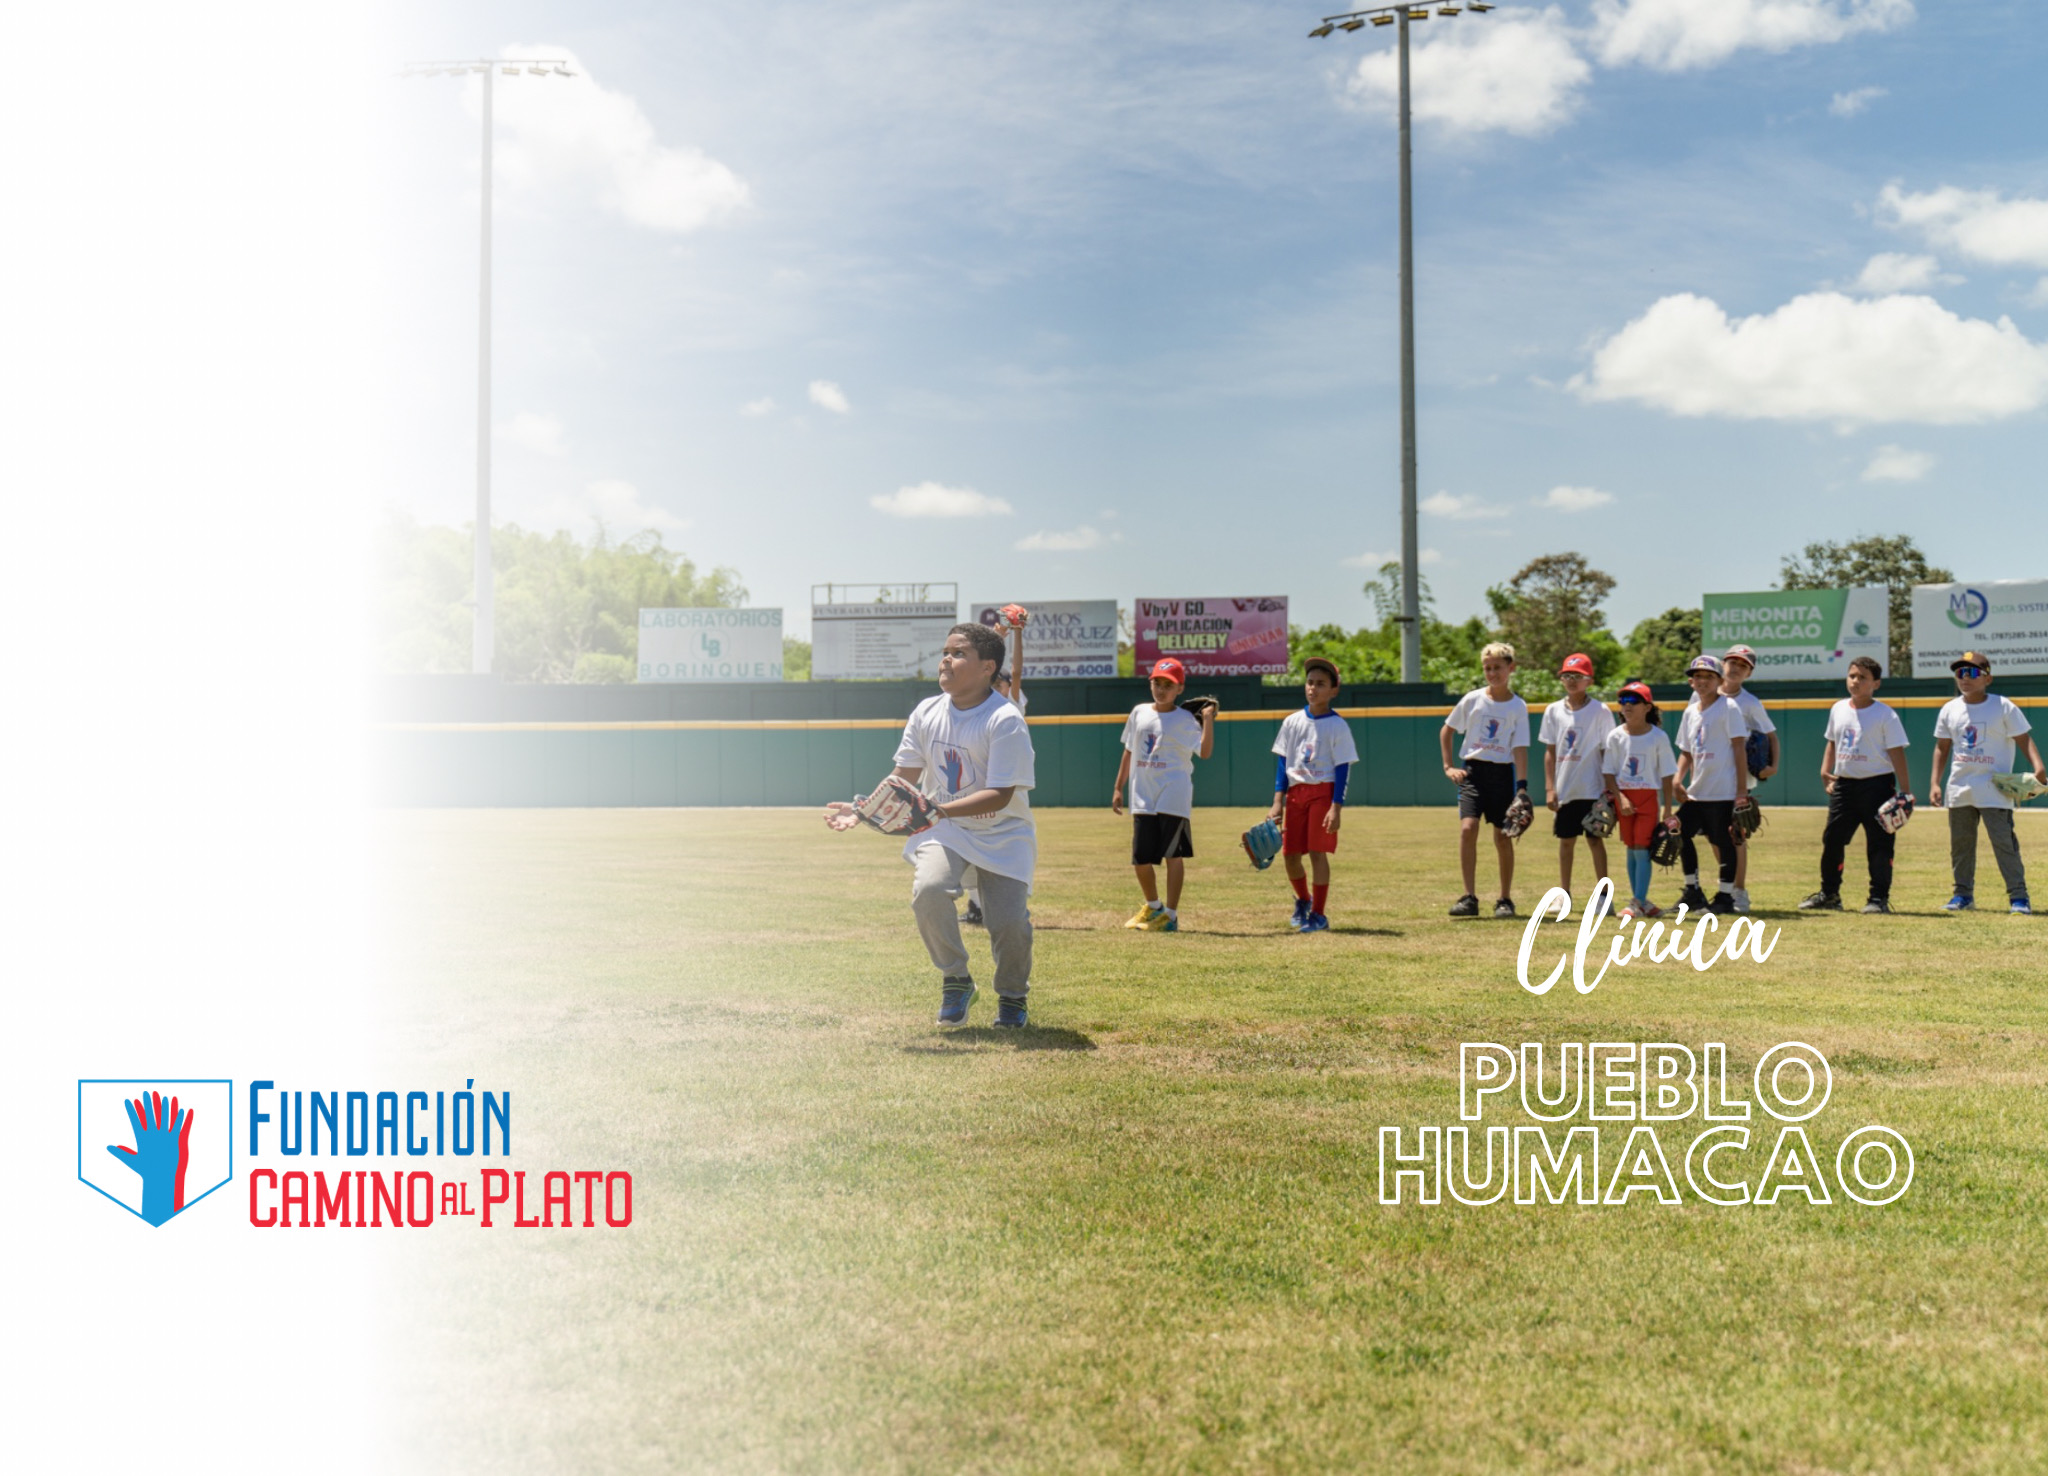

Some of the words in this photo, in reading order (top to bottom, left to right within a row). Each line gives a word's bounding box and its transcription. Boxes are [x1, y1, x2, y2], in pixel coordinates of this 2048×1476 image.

[915, 604, 956, 614] FLORES
[1142, 601, 1179, 618] VbyV
[1710, 606, 1823, 624] MENONITA
[1991, 604, 2016, 614] DATA
[641, 611, 782, 628] LABORATORIOS
[1712, 624, 1822, 641] HUMACAO
[1073, 640, 1113, 649] Notario
[1157, 632, 1228, 650] DELIVERY
[2000, 657, 2009, 665] DE
[640, 662, 783, 678] BORINQUEN
